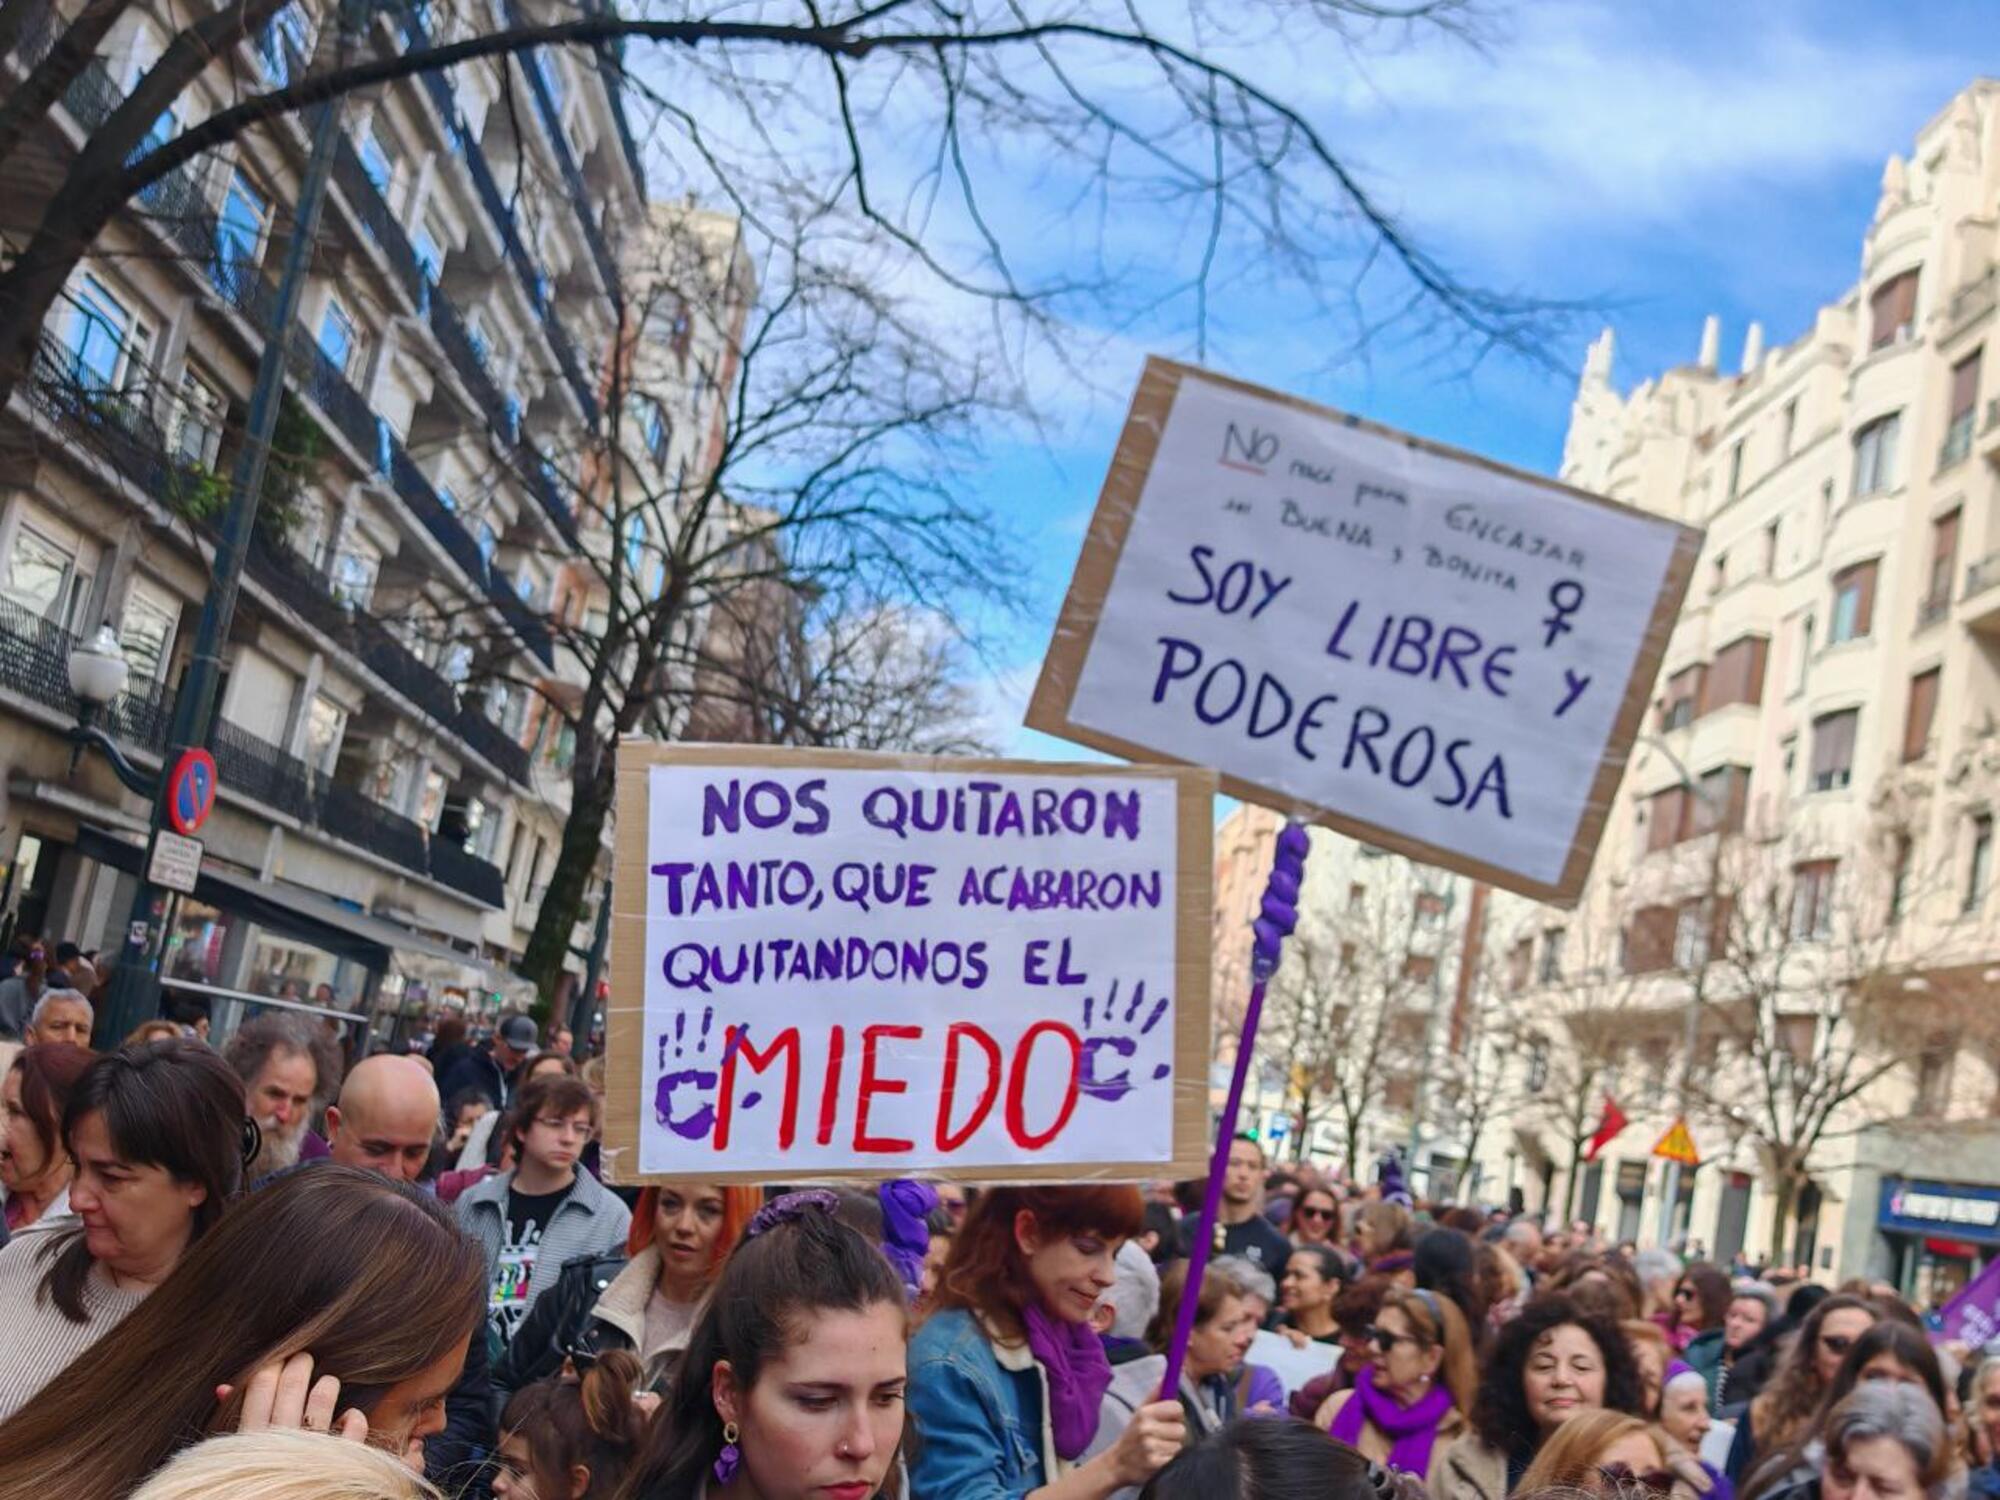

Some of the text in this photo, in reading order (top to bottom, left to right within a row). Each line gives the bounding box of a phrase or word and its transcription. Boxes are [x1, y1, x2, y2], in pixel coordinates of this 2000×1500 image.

[1221, 421, 1279, 465] NO
[1444, 503, 1585, 568] ENCAJAR
[1280, 499, 1372, 549] BUENA
[1424, 543, 1516, 591] BONITA
[1167, 545, 1291, 620] SOY
[1325, 600, 1517, 698] LIBRE
[1151, 636, 1514, 820] PODEROSA
[702, 779, 830, 837] NOS
[651, 860, 1162, 916] TANTO, QUE ACABARON
[662, 936, 1088, 993] QUITANDONOS EL
[712, 1020, 1083, 1153] MIEDO
